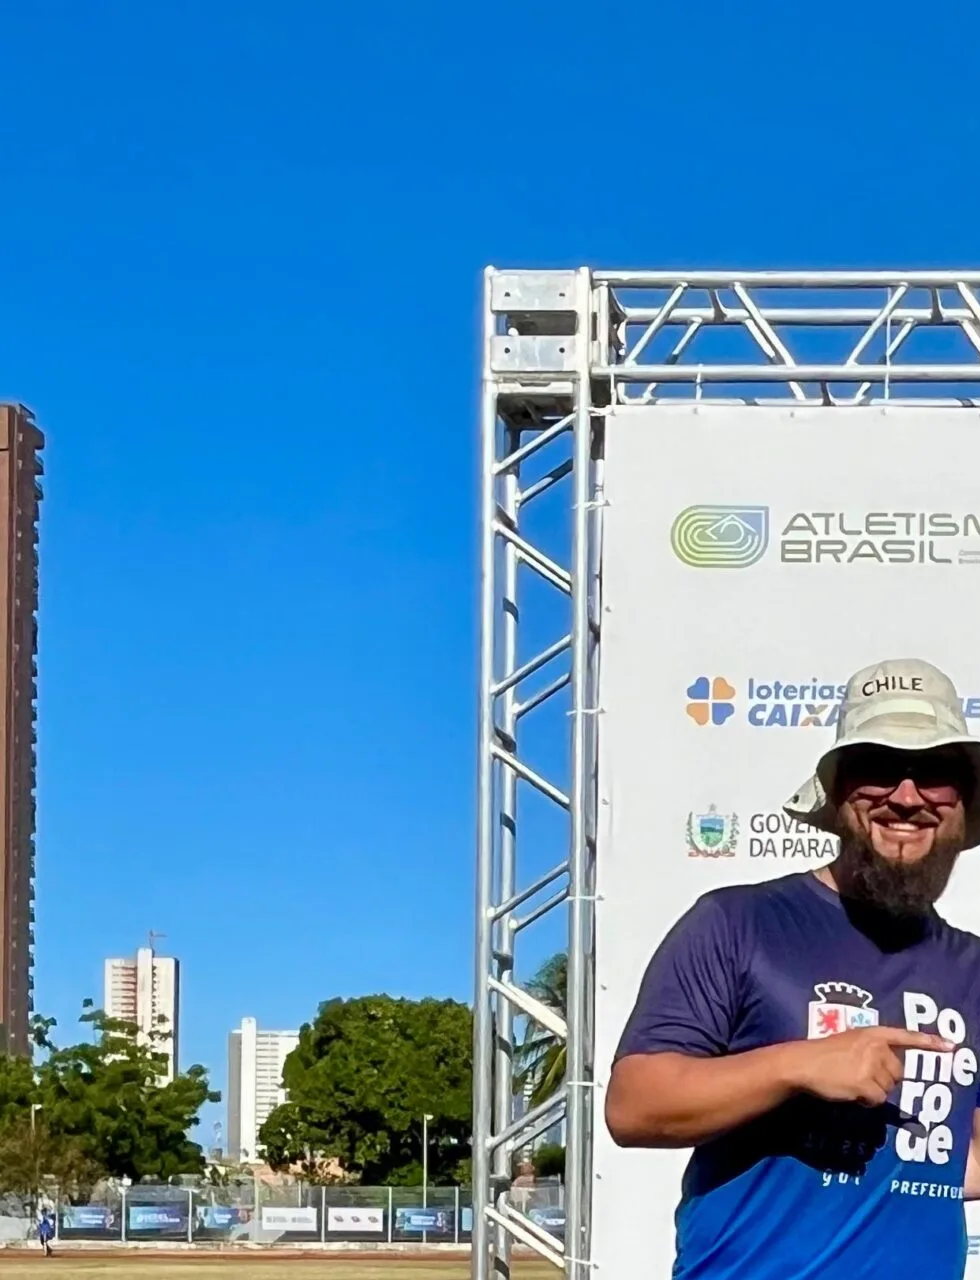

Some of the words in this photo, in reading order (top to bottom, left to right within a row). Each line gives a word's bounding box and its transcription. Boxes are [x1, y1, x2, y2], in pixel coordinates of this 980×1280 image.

[781, 540, 952, 563] BRASIL
[862, 676, 923, 697] CHILE
[750, 839, 777, 858] DA
